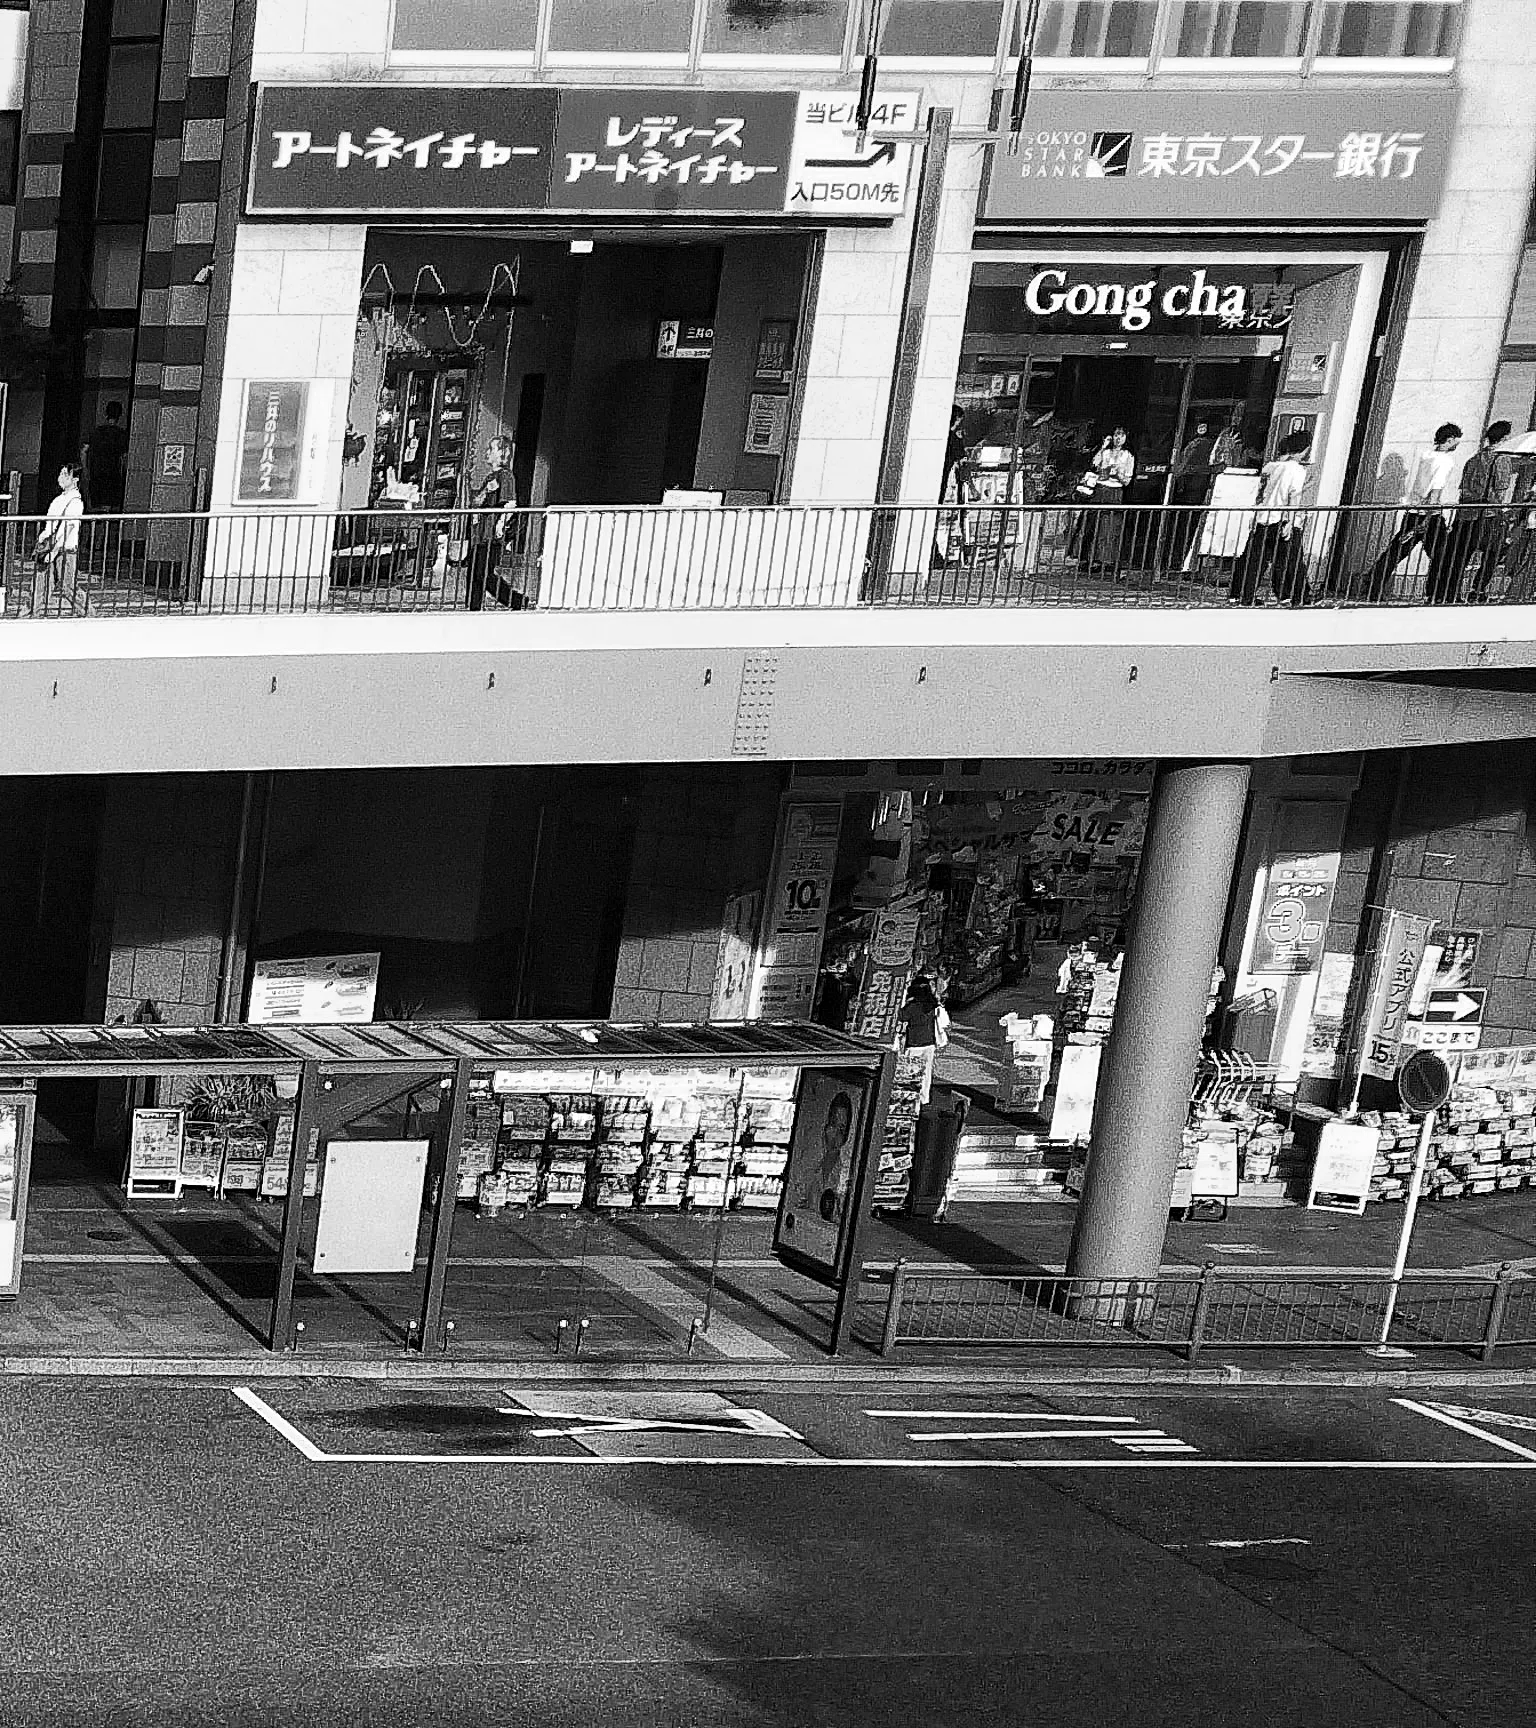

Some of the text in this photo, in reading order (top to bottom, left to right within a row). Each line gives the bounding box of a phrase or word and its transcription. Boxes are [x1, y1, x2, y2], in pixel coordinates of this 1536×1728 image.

[271, 126, 541, 169] アートネイチャー
[605, 115, 746, 149] レディース
[564, 150, 780, 185] アートネイチャー
[1023, 147, 1084, 160] STAR
[1136, 131, 1426, 178] 東京スター銀行
[1020, 164, 1081, 178] BANK
[789, 180, 901, 204] 入口50M先
[1026, 268, 1247, 331] Gong cha
[257, 391, 281, 493] 三井のリハウス
[1050, 812, 1125, 846] SALE
[1422, 1031, 1477, 1045] ここまで
